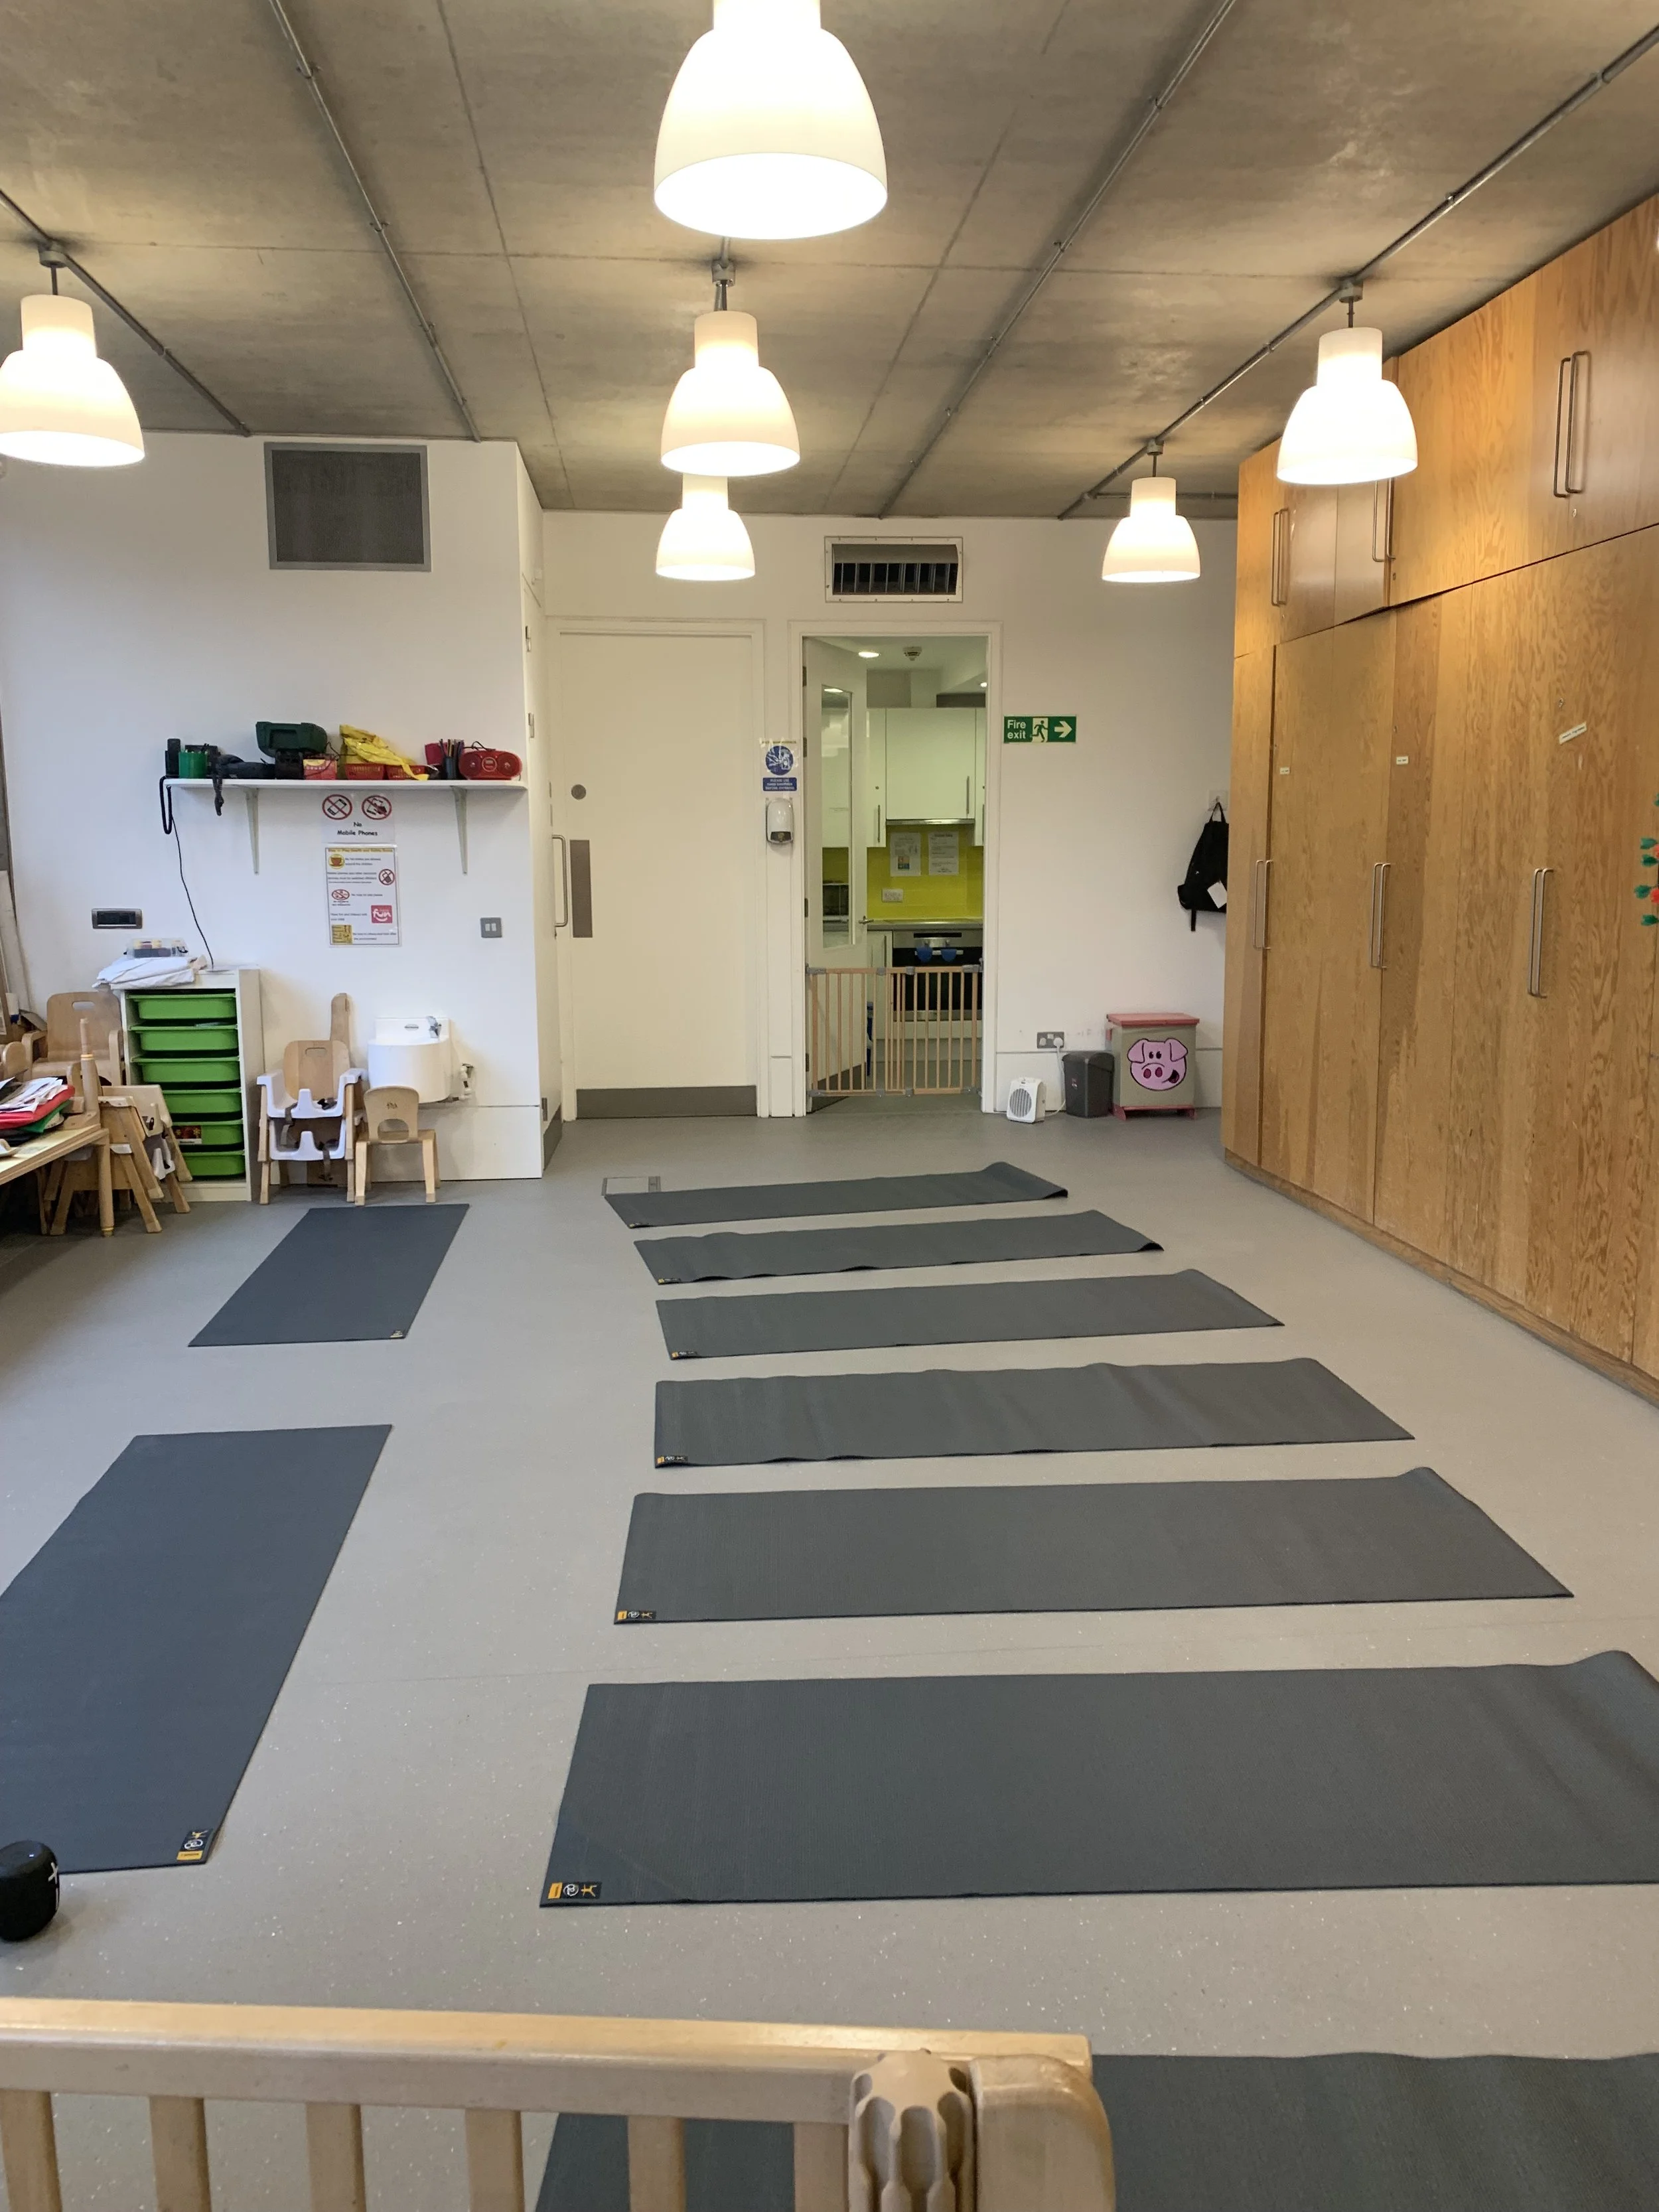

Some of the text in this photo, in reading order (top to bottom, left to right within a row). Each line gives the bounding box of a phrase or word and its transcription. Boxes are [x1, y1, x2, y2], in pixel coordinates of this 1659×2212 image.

[1007, 719, 1026, 729] Fire
[1007, 730, 1026, 739] exit
[372, 908, 392, 918] fun
